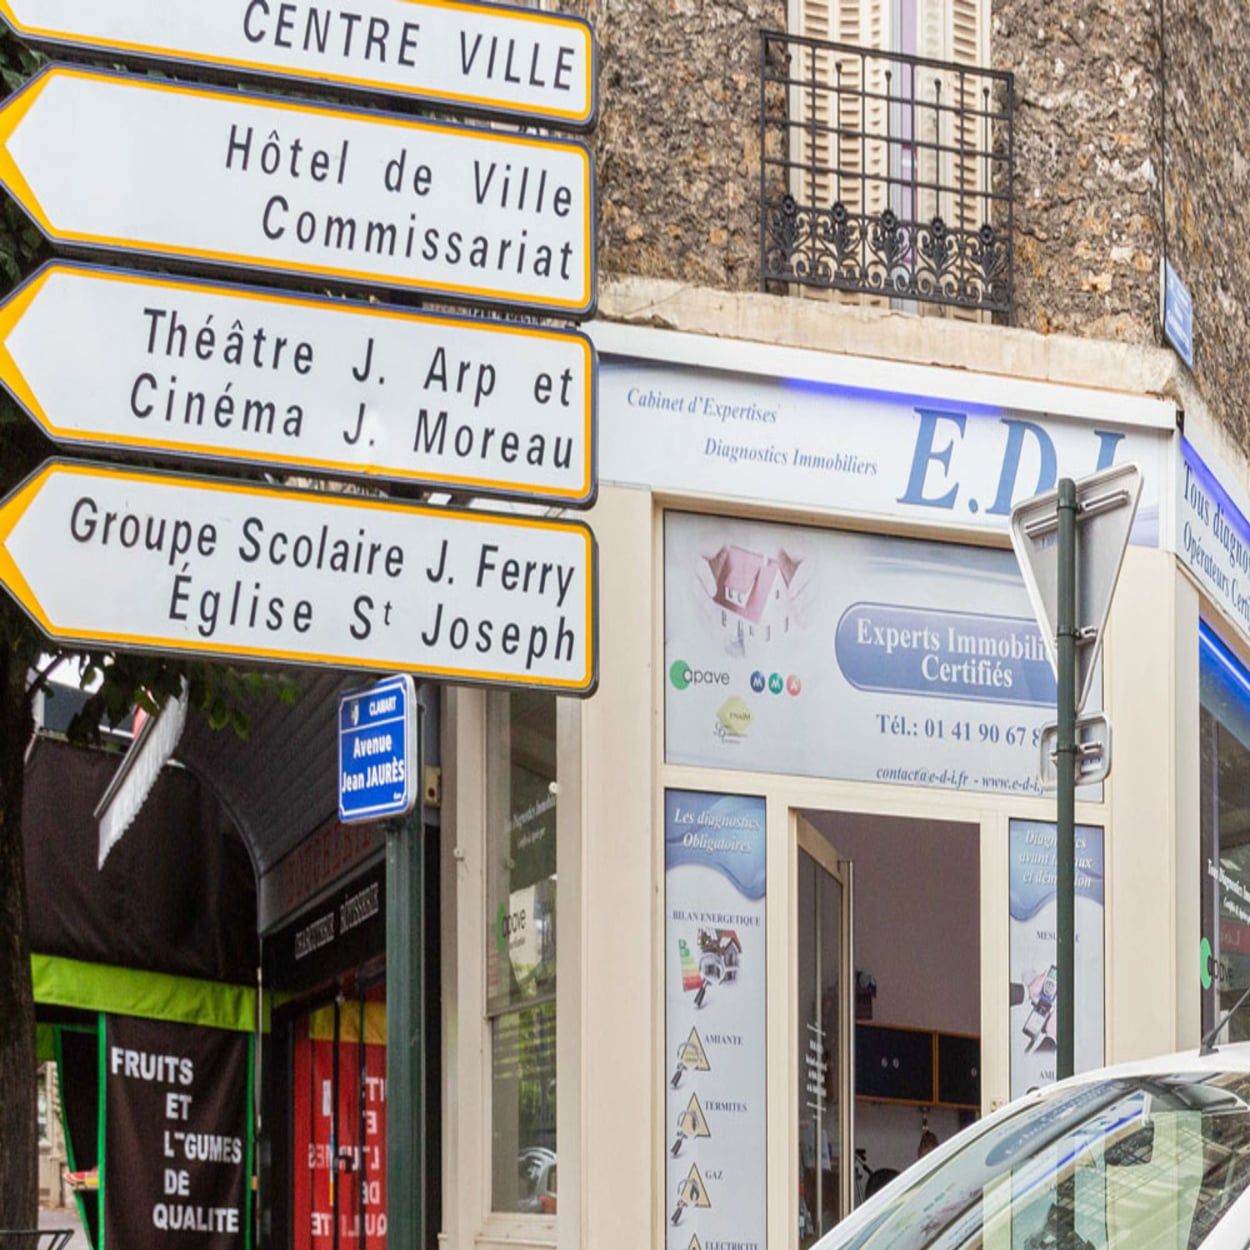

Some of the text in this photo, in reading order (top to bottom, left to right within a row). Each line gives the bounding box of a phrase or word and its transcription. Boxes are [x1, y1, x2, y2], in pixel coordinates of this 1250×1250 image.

[243, 0, 576, 91] CENTRE VILLE
[225, 124, 573, 217] Hôtel de Ville
[262, 194, 574, 281] Commissariat
[143, 308, 574, 407] Théâtre J. Arp et
[130, 372, 573, 470] Cinéma J. Moreau
[627, 387, 777, 426] Cabinet d'Expertises
[704, 437, 878, 476] Diagnostics Immobiliers
[1184, 460, 1209, 526] Tous
[70, 497, 575, 607] Groupe Scolaire J. Ferry
[168, 563, 575, 669] Église St Joseph
[856, 617, 1051, 662] Experts Immobili
[682, 668, 730, 686] apave
[921, 652, 1013, 688] Certifiés
[369, 696, 397, 716] CLAMART
[353, 734, 392, 758] Avenue
[925, 719, 944, 738] 01
[952, 721, 970, 741] 41
[979, 724, 999, 743] 90
[1006, 726, 1026, 746] 67
[342, 757, 404, 793] Jean JAURÈS
[674, 808, 694, 824] Les
[672, 910, 699, 922] BILAN
[705, 1034, 743, 1047] AMIANTE
[111, 1046, 194, 1086] FRUITS
[166, 1094, 192, 1120] ET
[705, 1100, 748, 1113] TERMITES
[164, 1168, 190, 1196] DE
[705, 1169, 723, 1181] GAZ
[153, 1204, 239, 1233] QUALITE
